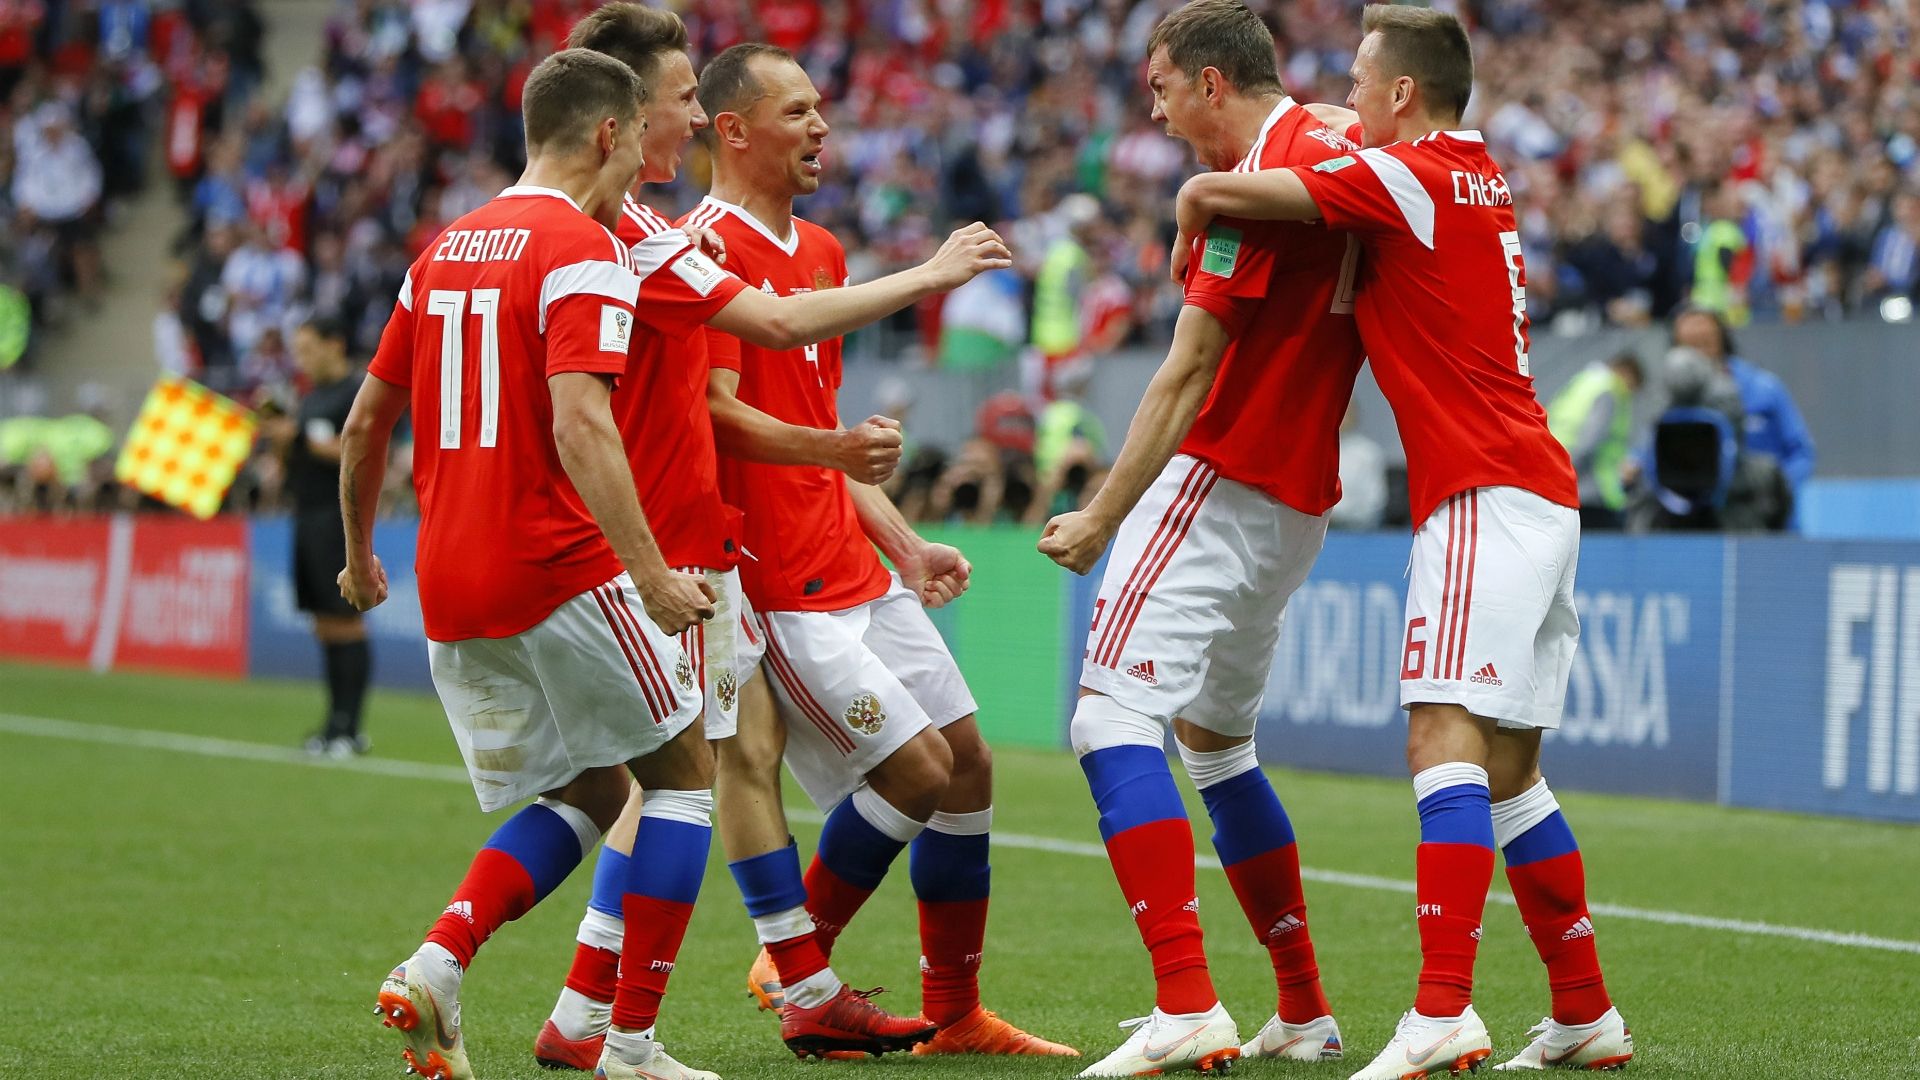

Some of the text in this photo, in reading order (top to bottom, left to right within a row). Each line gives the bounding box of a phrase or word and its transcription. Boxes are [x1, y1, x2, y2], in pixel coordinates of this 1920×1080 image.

[433, 228, 532, 263] ZOBNIN
[426, 287, 502, 449] 11
[1400, 616, 1427, 681] 6
[1126, 667, 1159, 685] adidas
[1469, 675, 1503, 687] adidas
